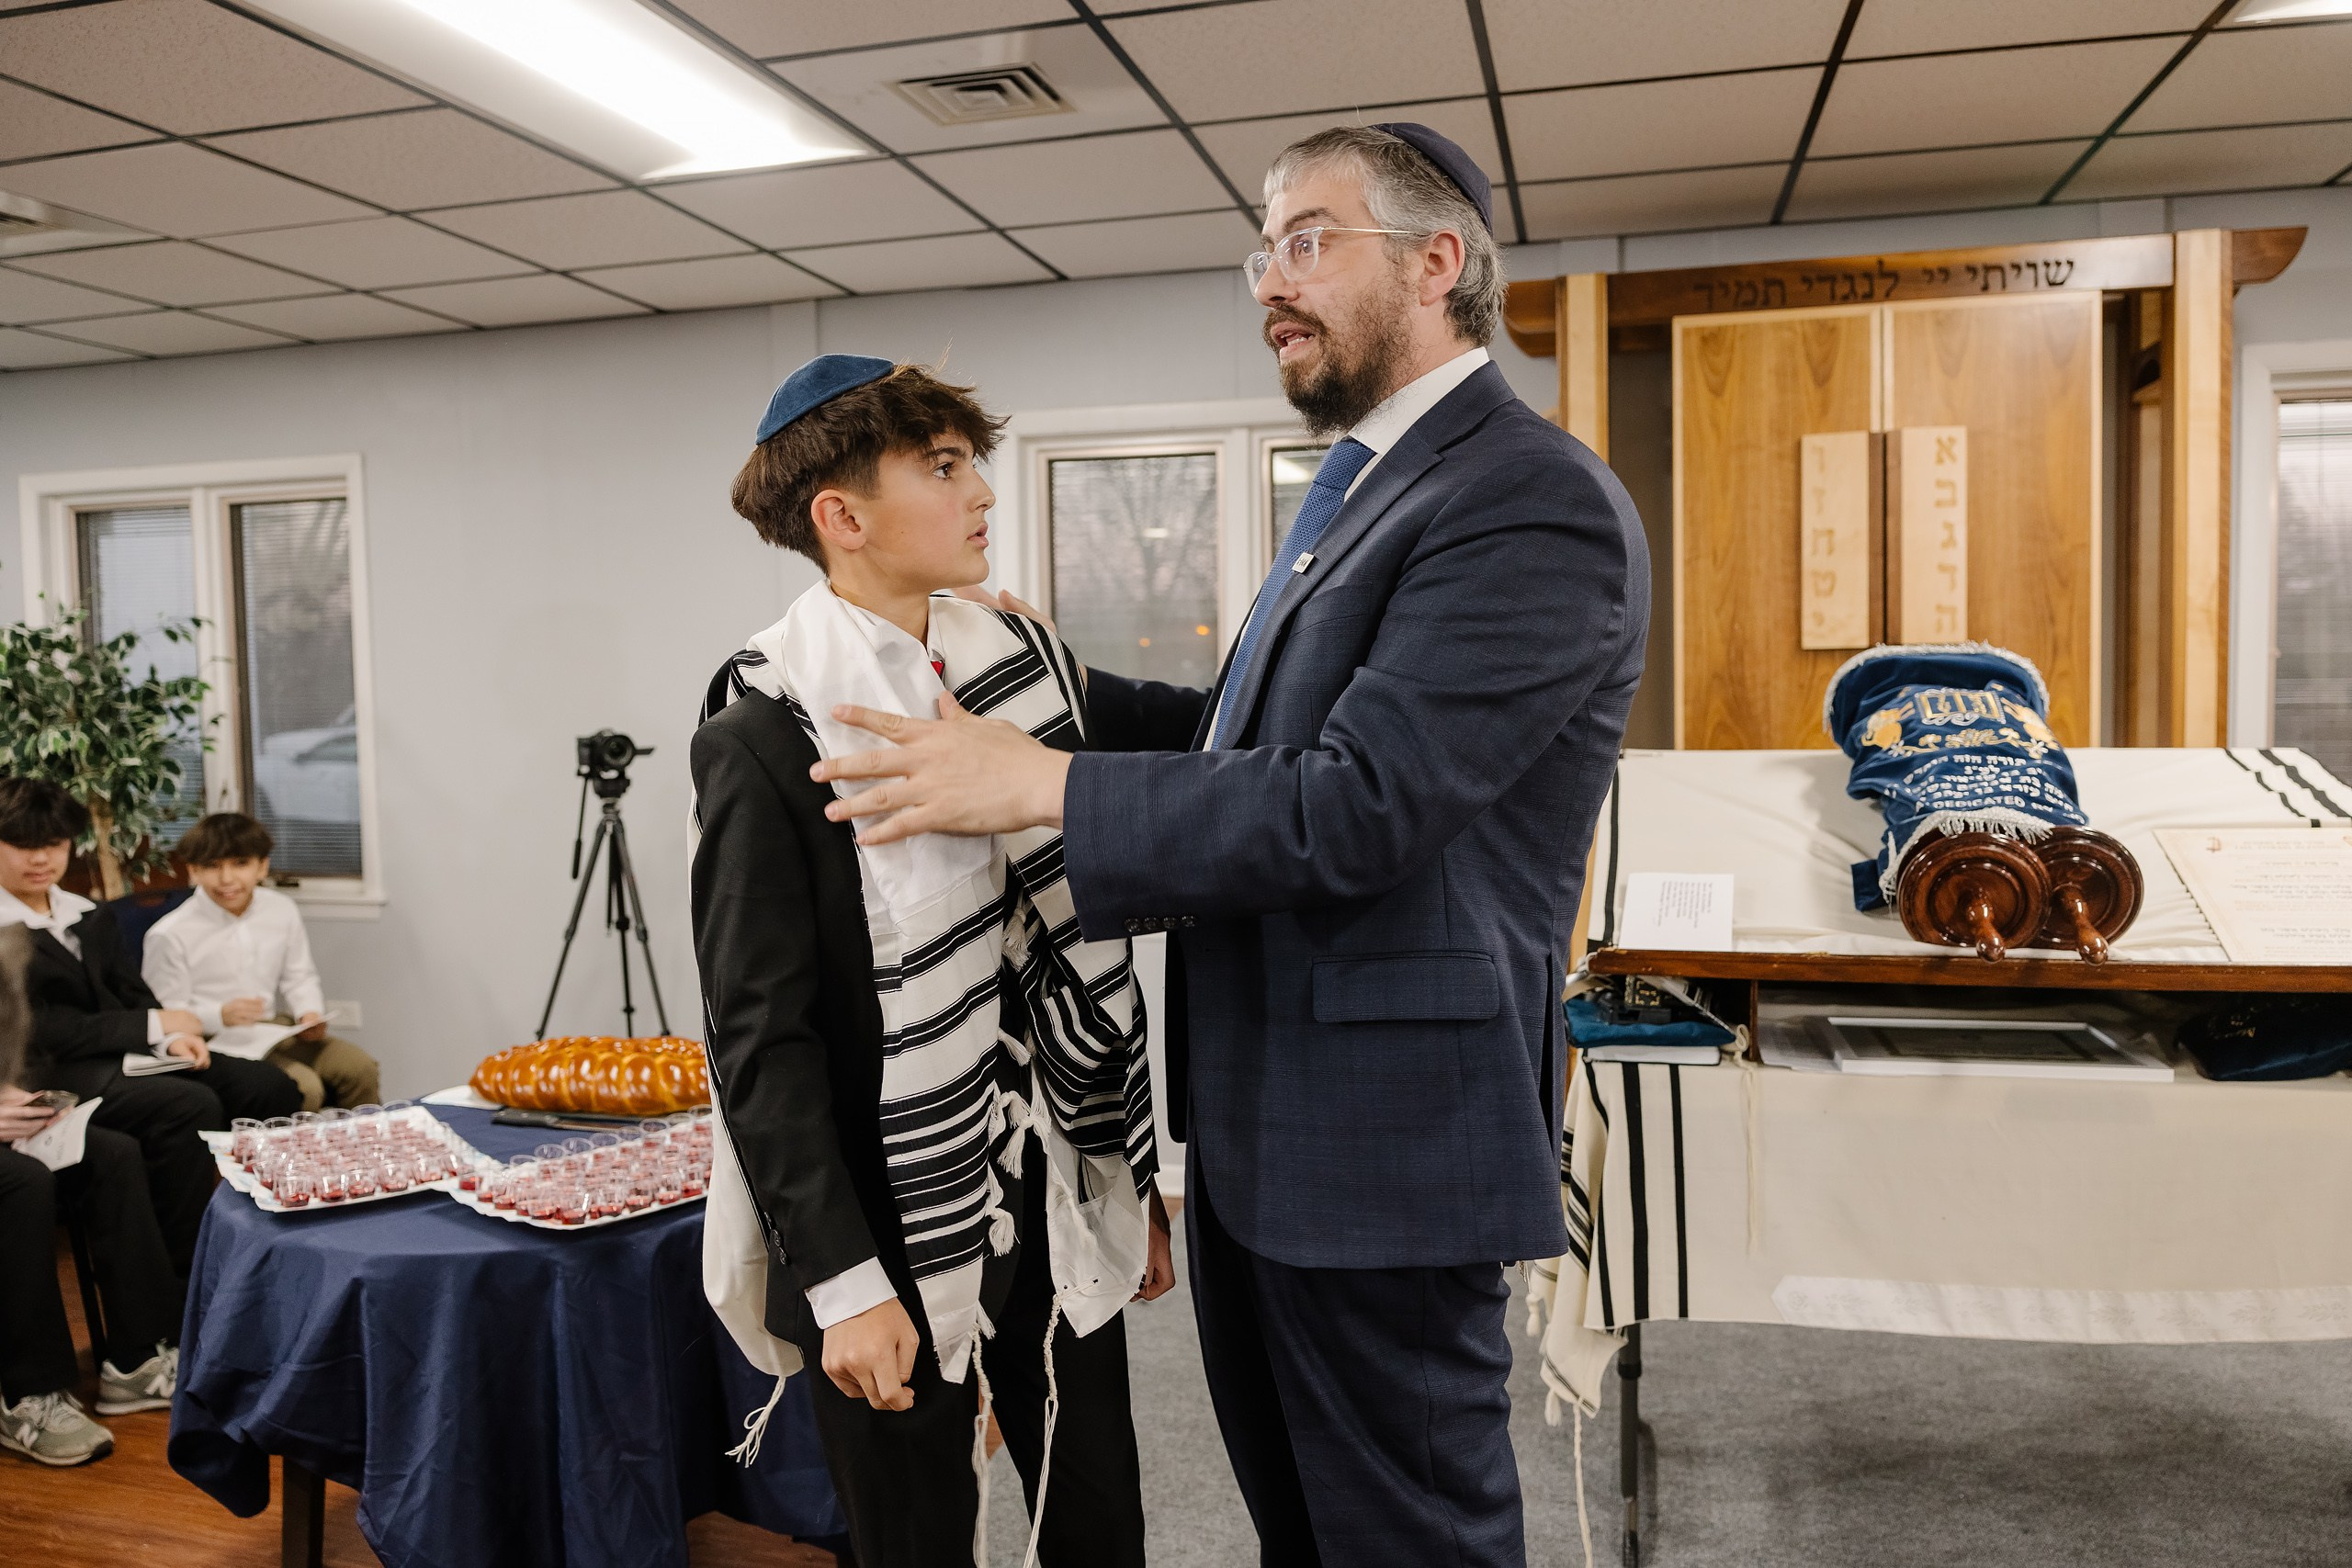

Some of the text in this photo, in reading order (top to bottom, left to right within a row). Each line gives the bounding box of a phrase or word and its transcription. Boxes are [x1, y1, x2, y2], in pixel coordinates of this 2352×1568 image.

[1691, 257, 2075, 311] שויתי יי לנגדי תמיד
[1932, 795, 2026, 808] DEDICATED
